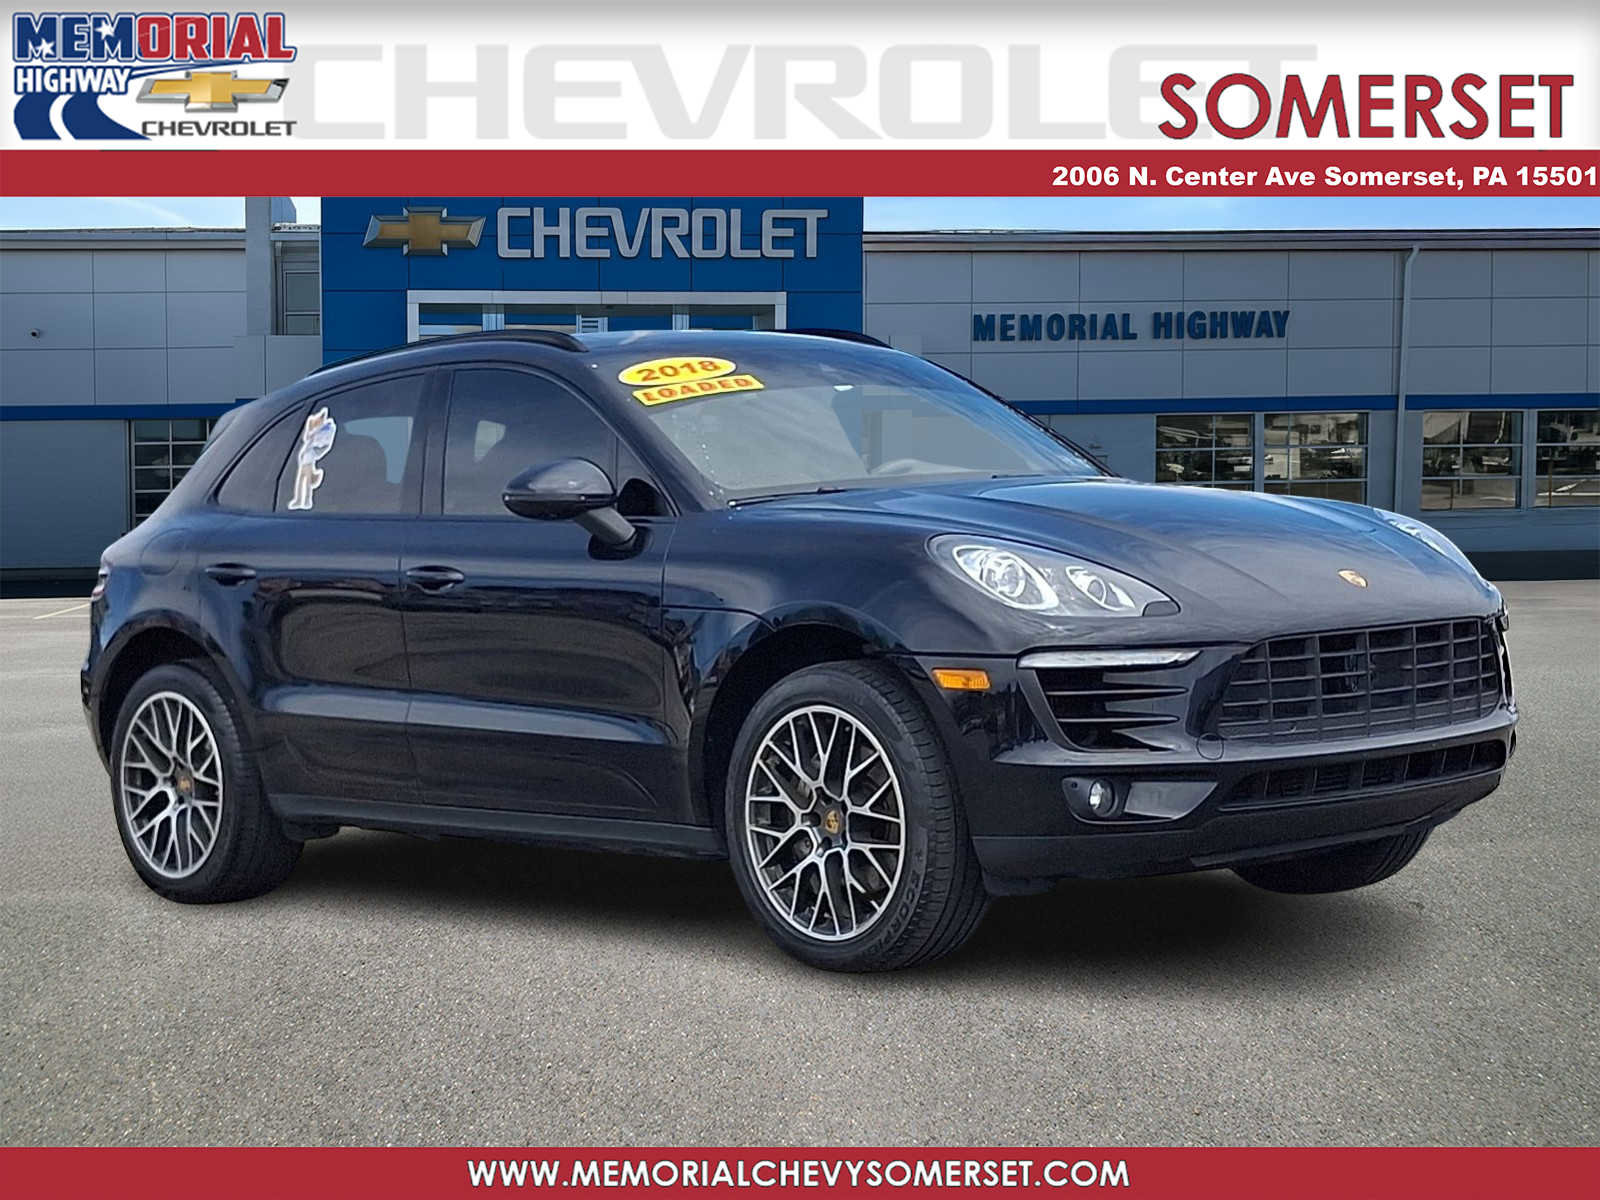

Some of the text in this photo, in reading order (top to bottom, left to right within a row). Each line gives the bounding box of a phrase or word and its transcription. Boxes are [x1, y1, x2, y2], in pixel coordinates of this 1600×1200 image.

[496, 206, 829, 259] CHEVROLET
[972, 310, 1291, 342] MEMORIAL HIGHWAY
[637, 360, 721, 382] 2018
[642, 378, 753, 401] LOADED
